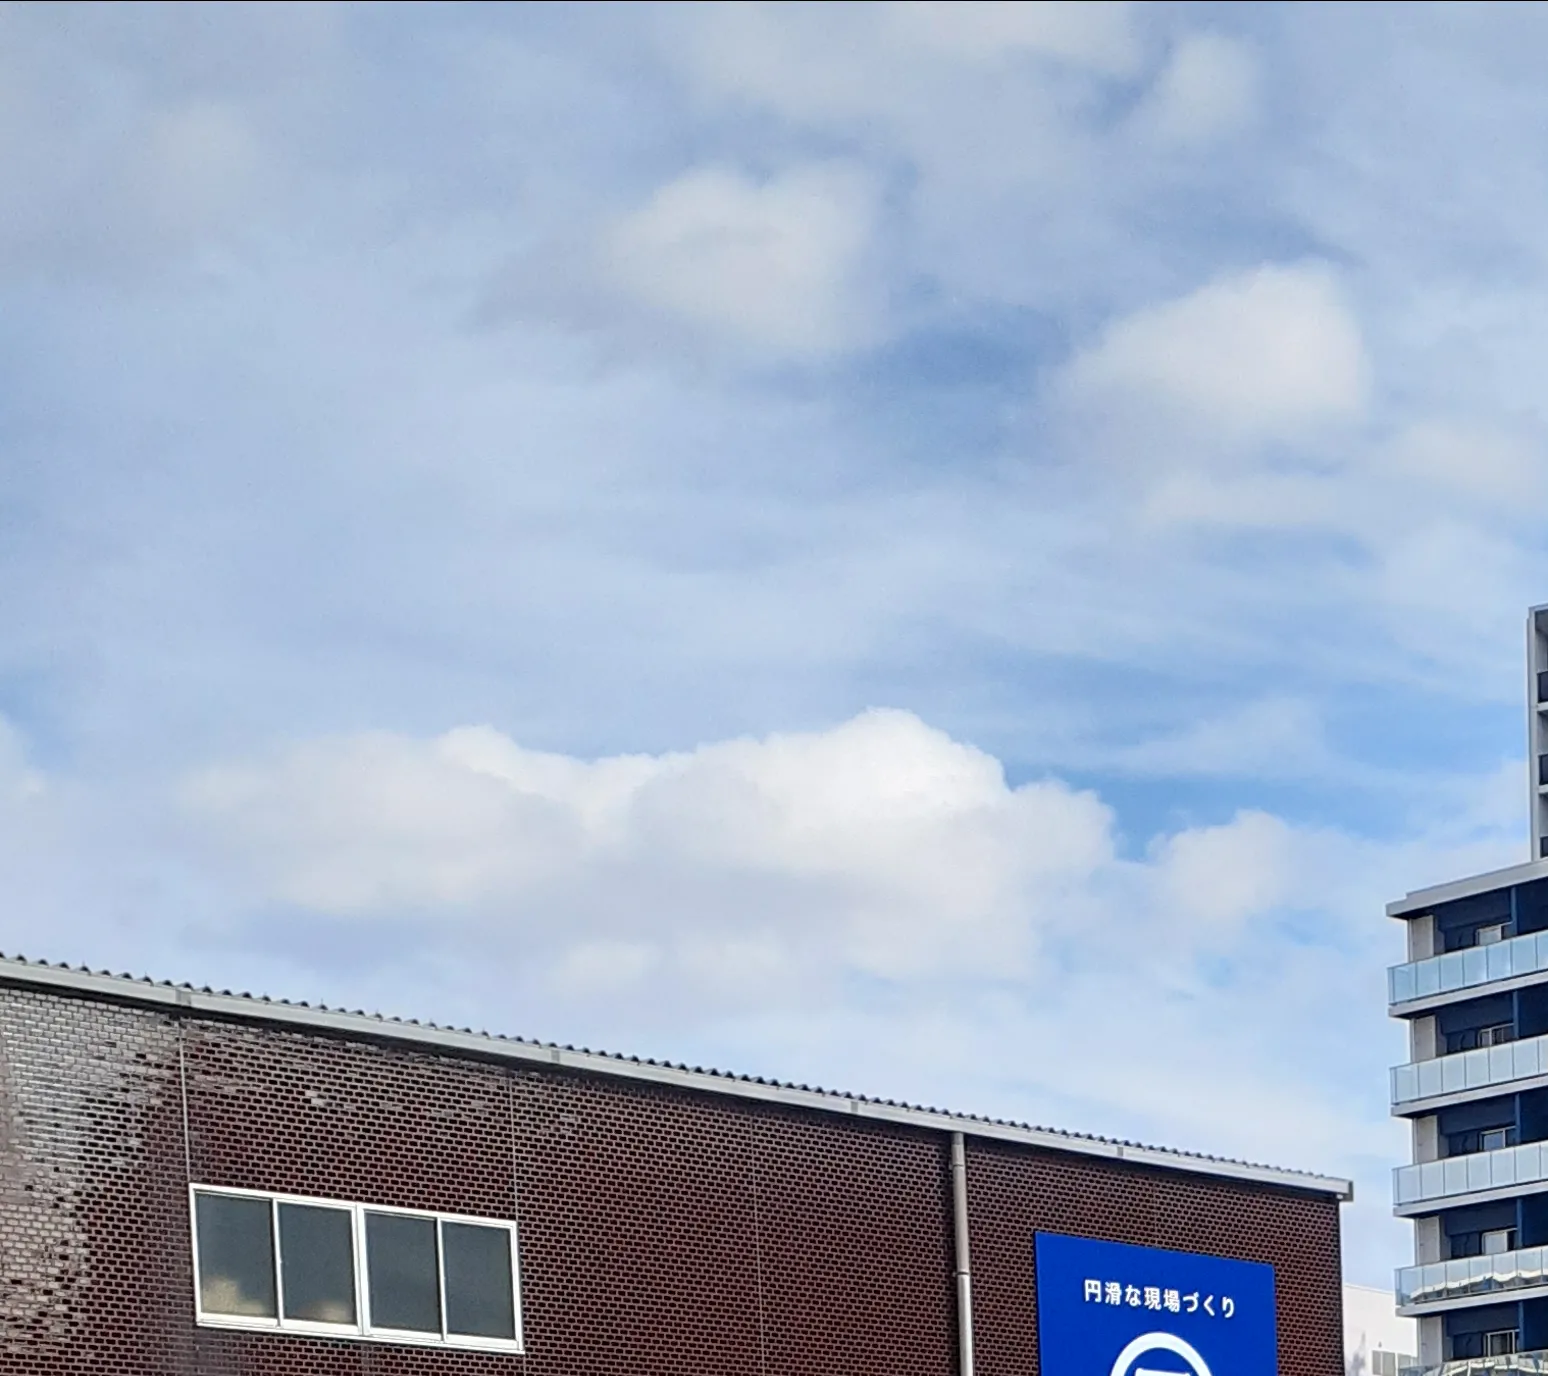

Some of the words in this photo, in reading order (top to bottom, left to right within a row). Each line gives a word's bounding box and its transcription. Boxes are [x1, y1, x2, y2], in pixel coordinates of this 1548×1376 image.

[1085, 1279, 1234, 1318] 円滑な現場づくり
